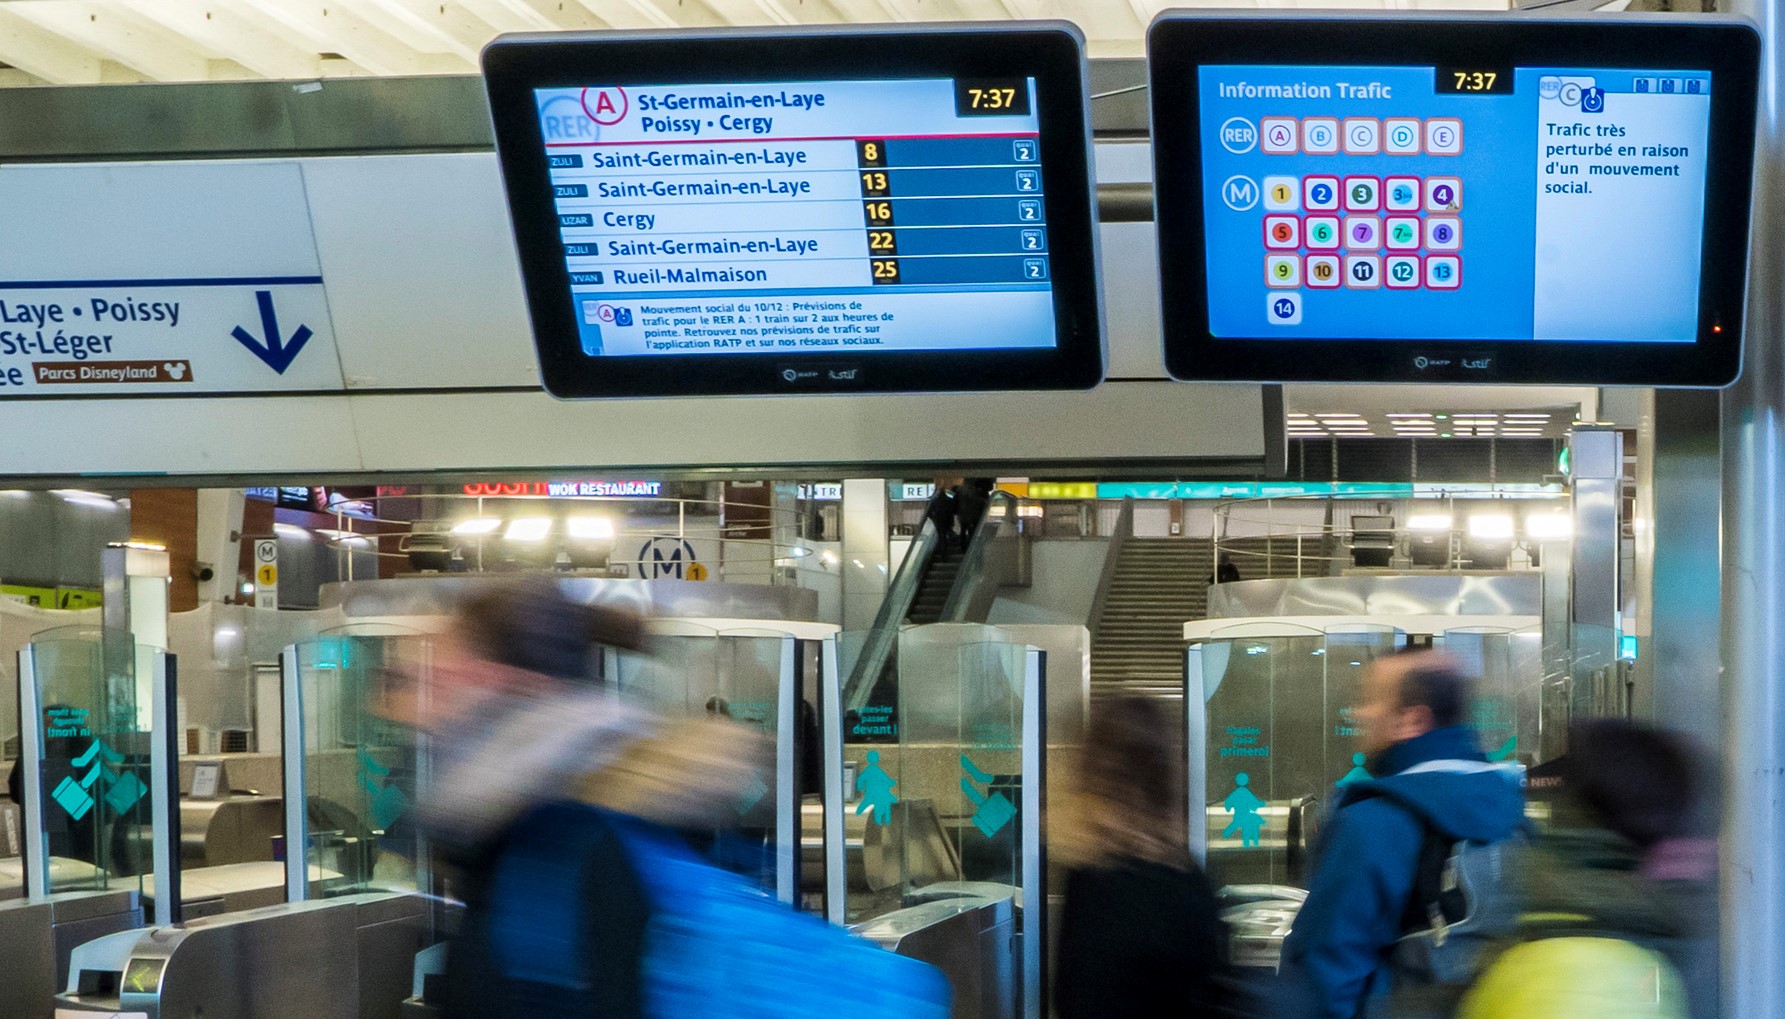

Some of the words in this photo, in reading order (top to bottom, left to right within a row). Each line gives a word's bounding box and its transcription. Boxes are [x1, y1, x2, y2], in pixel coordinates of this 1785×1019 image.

[1453, 72, 1497, 90] 7:37
[1218, 82, 1332, 98] Information
[1336, 81, 1392, 99] Trafic
[1566, 88, 1576, 101] C
[596, 91, 617, 114] A
[638, 91, 825, 111] St-Germain-en-Laye
[968, 88, 1015, 109] 7:37
[545, 115, 591, 138] RER
[642, 116, 701, 135] Poissy
[720, 114, 773, 134] Cergy
[1546, 123, 1591, 137] Trafic
[1597, 124, 1626, 137] très
[1224, 127, 1253, 143] RER
[1274, 130, 1285, 141] A
[1316, 130, 1326, 142] B
[1357, 130, 1367, 142] C
[1397, 131, 1408, 142] D
[1440, 131, 1448, 143] E
[864, 143, 878, 160] 8
[1020, 147, 1029, 160] 2
[1546, 143, 1613, 158] perturbé
[1618, 145, 1637, 156] en
[1642, 143, 1689, 157] raison
[593, 149, 807, 168] Saint-Germain-en-Laye
[1545, 161, 1579, 175] d'un
[1589, 164, 1680, 176] mouvement
[598, 178, 811, 198] Saint-Germain-en-Laye
[862, 172, 887, 190] 13
[1022, 178, 1032, 190] 2
[1545, 181, 1593, 194] social.
[1230, 183, 1251, 204] M
[1276, 188, 1285, 199] 1
[1317, 188, 1327, 200] 2
[1357, 188, 1367, 200] 3
[1437, 188, 1448, 202] 4
[866, 202, 891, 219] 16
[1025, 207, 1034, 219] 2
[603, 211, 656, 230] Cergy
[1279, 227, 1287, 239] 5
[1318, 227, 1327, 239] 6
[1359, 227, 1367, 239] 7
[1438, 227, 1448, 240] 8
[608, 238, 818, 257] Saint-Germain-en-Laye
[869, 232, 894, 249] 22
[1027, 236, 1037, 248] 2
[614, 267, 767, 285] Rueil-Malmaison
[873, 261, 897, 278] 25
[1030, 265, 1039, 277] 2
[1279, 265, 1288, 277] 9
[1315, 265, 1331, 277] 10
[1354, 265, 1371, 277] 11
[1394, 265, 1411, 278] 12
[1433, 266, 1451, 278] 13
[572, 274, 598, 282] YVAN
[0, 301, 64, 329] Laye
[91, 297, 179, 327] Poissy
[640, 305, 702, 315] Mouvement
[705, 303, 735, 313] social
[737, 303, 751, 312] du
[755, 302, 783, 312] 10/12
[792, 301, 846, 311] Prévisions
[849, 301, 863, 311] de
[1276, 302, 1293, 314] 14
[642, 316, 670, 326] trafic
[673, 317, 697, 327] pour
[700, 315, 710, 325] le
[713, 315, 735, 325] RER
[738, 315, 746, 324] A
[755, 315, 761, 324] 1
[764, 314, 790, 324] train
[793, 315, 809, 323] sur
[812, 313, 818, 323] 2
[821, 314, 840, 323] aux
[843, 312, 878, 322] heures
[881, 311, 894, 321] de
[644, 329, 681, 340] pointe.
[684, 327, 737, 337] Retrouvez
[740, 328, 758, 336] nos
[761, 325, 814, 336] prévisions
[817, 324, 830, 334] de
[833, 323, 862, 334] trafic
[864, 324, 881, 333] sur
[0, 330, 113, 360] St-Léger
[646, 339, 711, 351] l'application
[713, 338, 742, 348] RATP
[745, 338, 756, 347] et
[760, 338, 774, 347] sur
[778, 338, 797, 346] nos
[799, 336, 839, 346] réseaux
[842, 335, 884, 345] sociaux.
[39, 367, 76, 380] Parcs
[80, 366, 157, 382] Disneyland
[549, 483, 578, 496] WOK
[579, 483, 661, 496] RESTAURANT
[262, 546, 274, 557] M
[654, 548, 682, 579] M
[852, 723, 892, 735] devant
